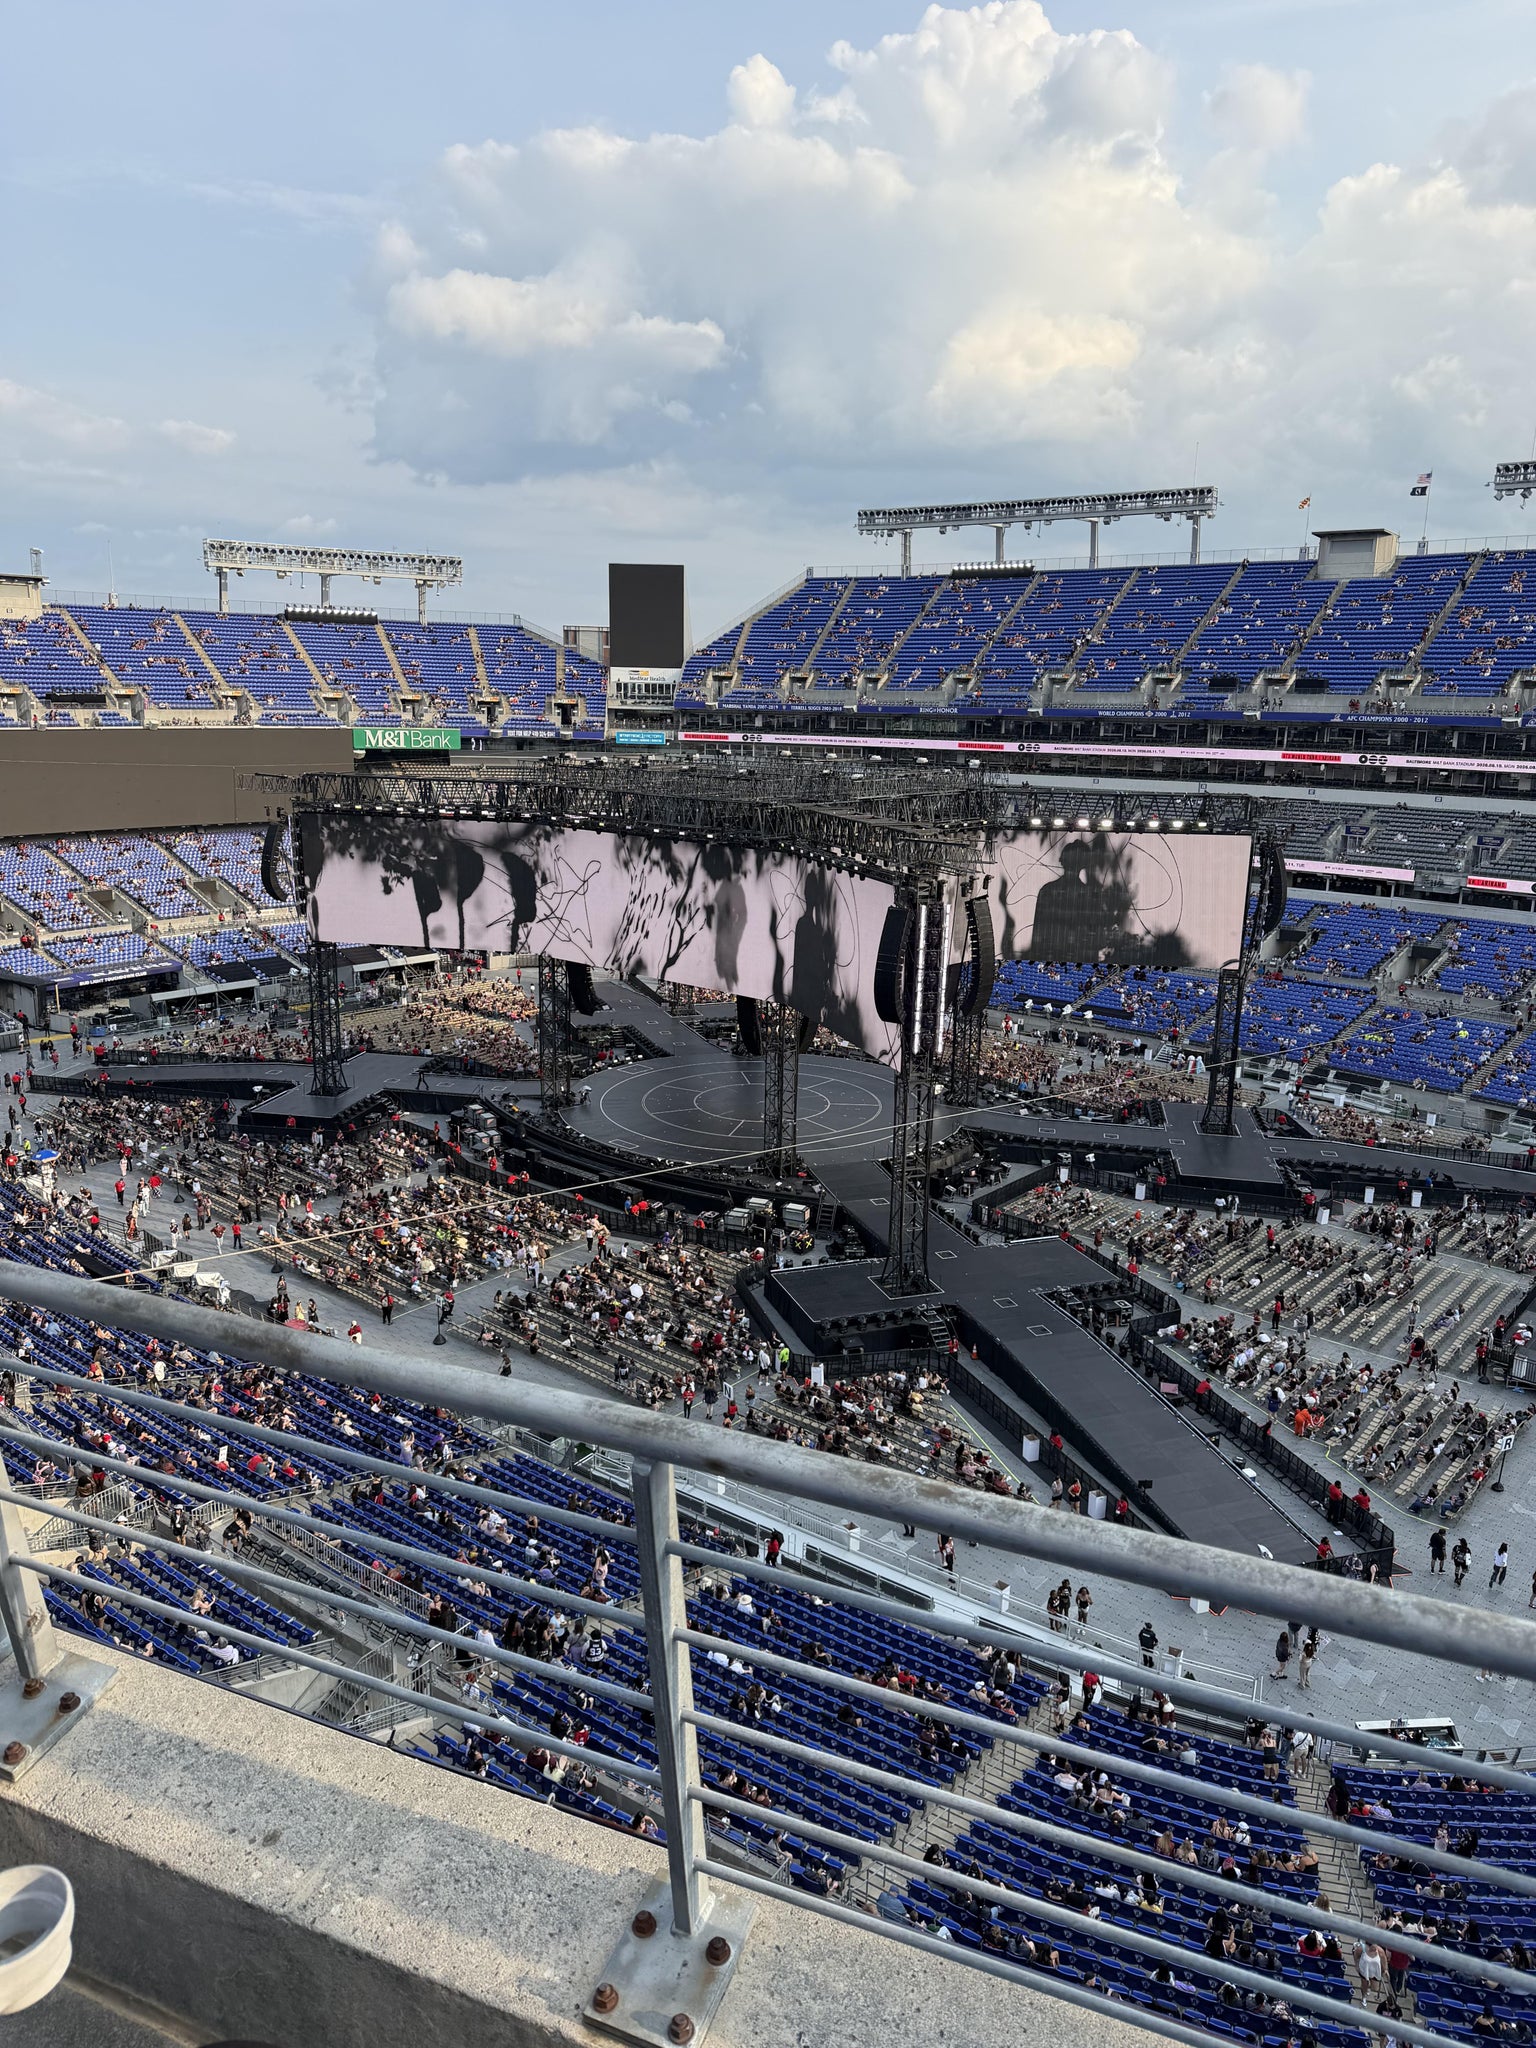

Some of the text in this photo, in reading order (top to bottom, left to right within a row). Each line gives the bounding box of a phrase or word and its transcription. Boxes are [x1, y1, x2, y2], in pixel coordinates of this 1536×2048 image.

[364, 729, 452, 748] M&T Bank
[105, 973, 135, 982] TOUCHDOWN
[725, 1384, 731, 1398] N
[1504, 1437, 1513, 1450] R
[590, 1647, 602, 1656] 93
